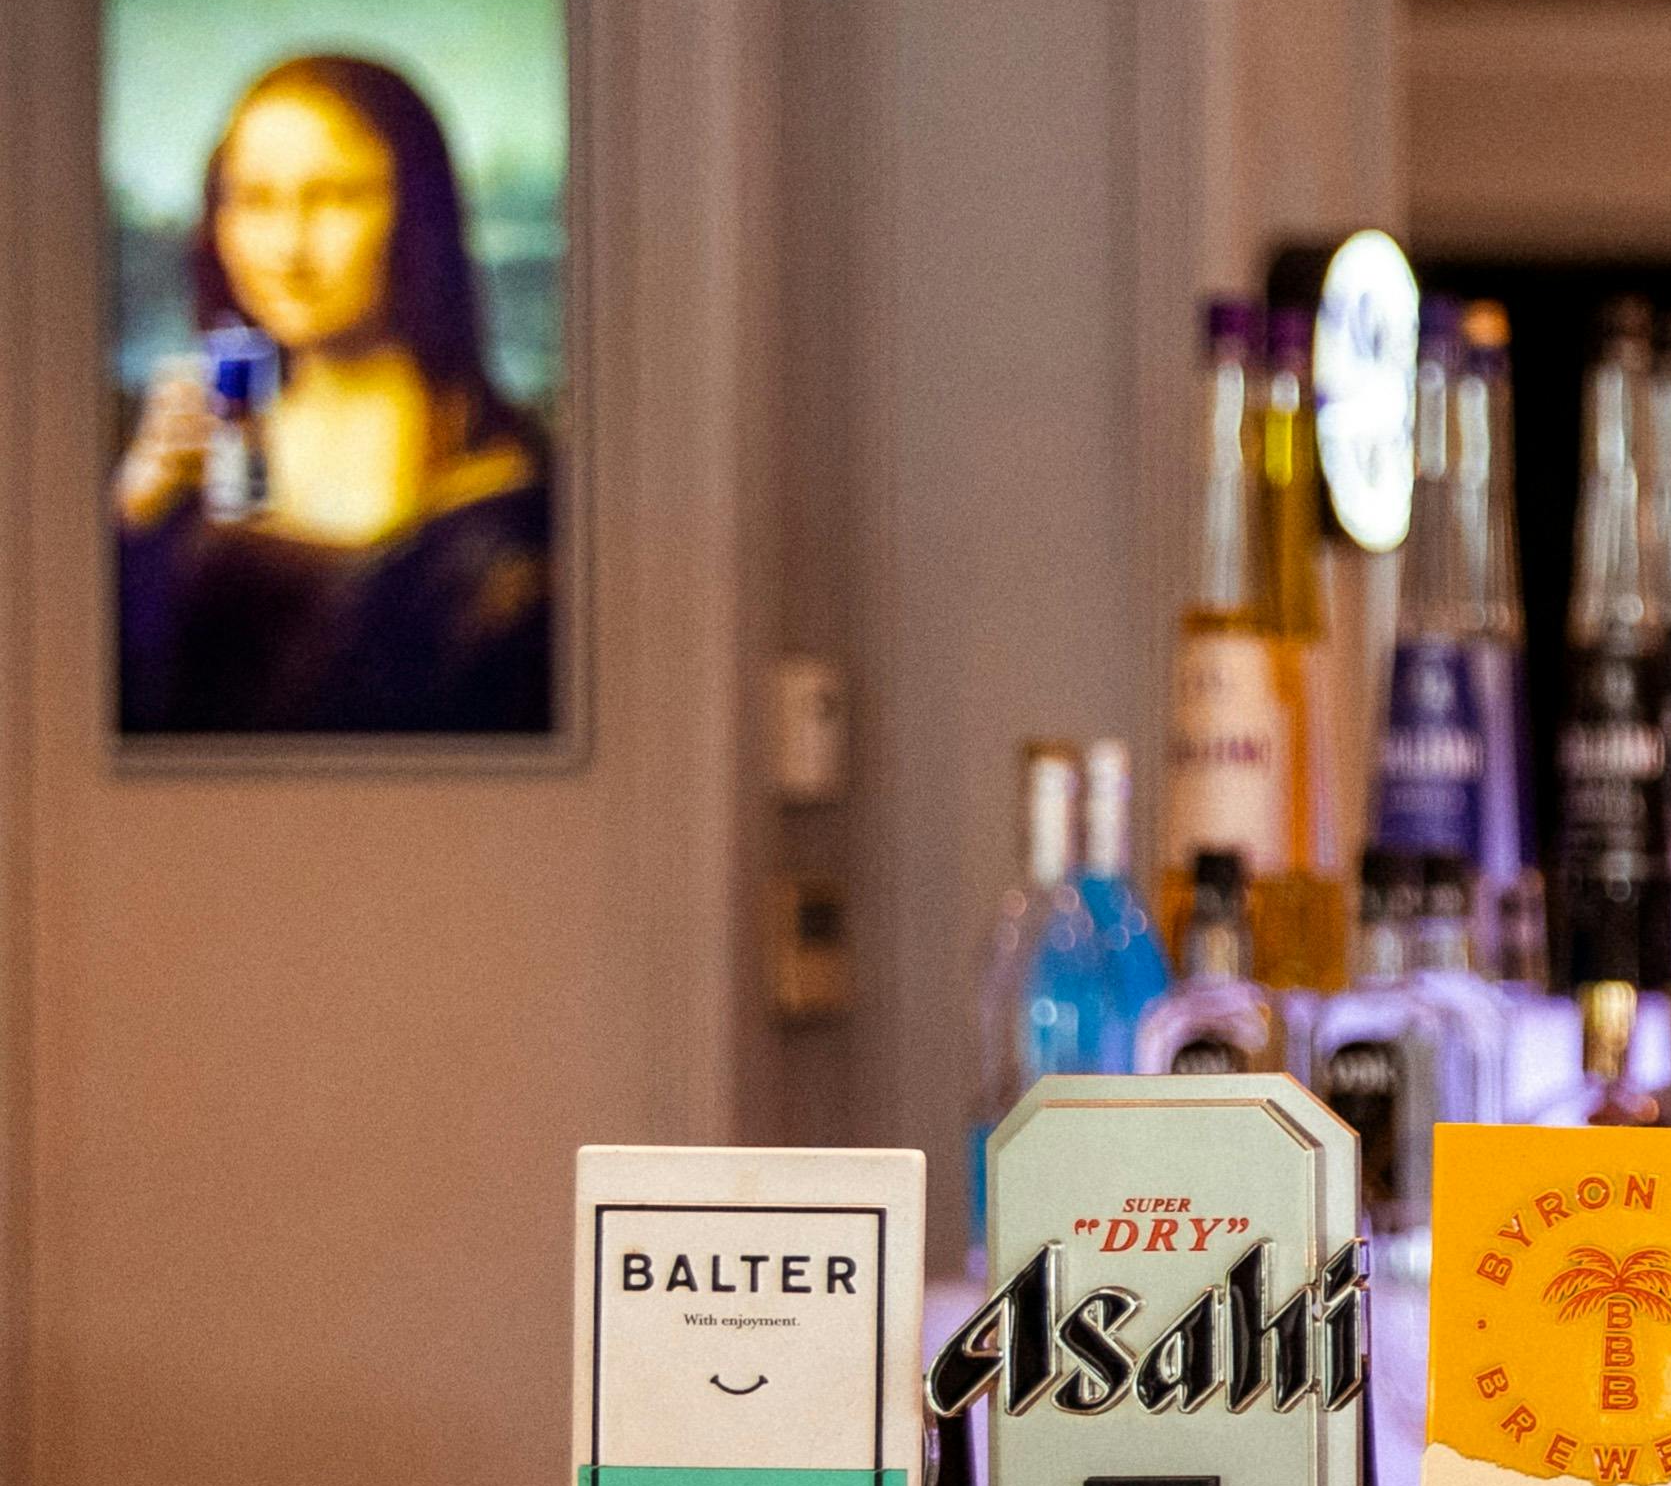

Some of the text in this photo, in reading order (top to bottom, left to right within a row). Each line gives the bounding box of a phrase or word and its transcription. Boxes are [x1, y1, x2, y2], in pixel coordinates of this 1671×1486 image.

[1123, 1198, 1191, 1212] SUPER
[1476, 1173, 1657, 1287] BYRON
[622, 1254, 859, 1295] BALTER
[683, 1313, 801, 1331] With enjoyment.
[927, 1238, 1372, 1418] Asahi
